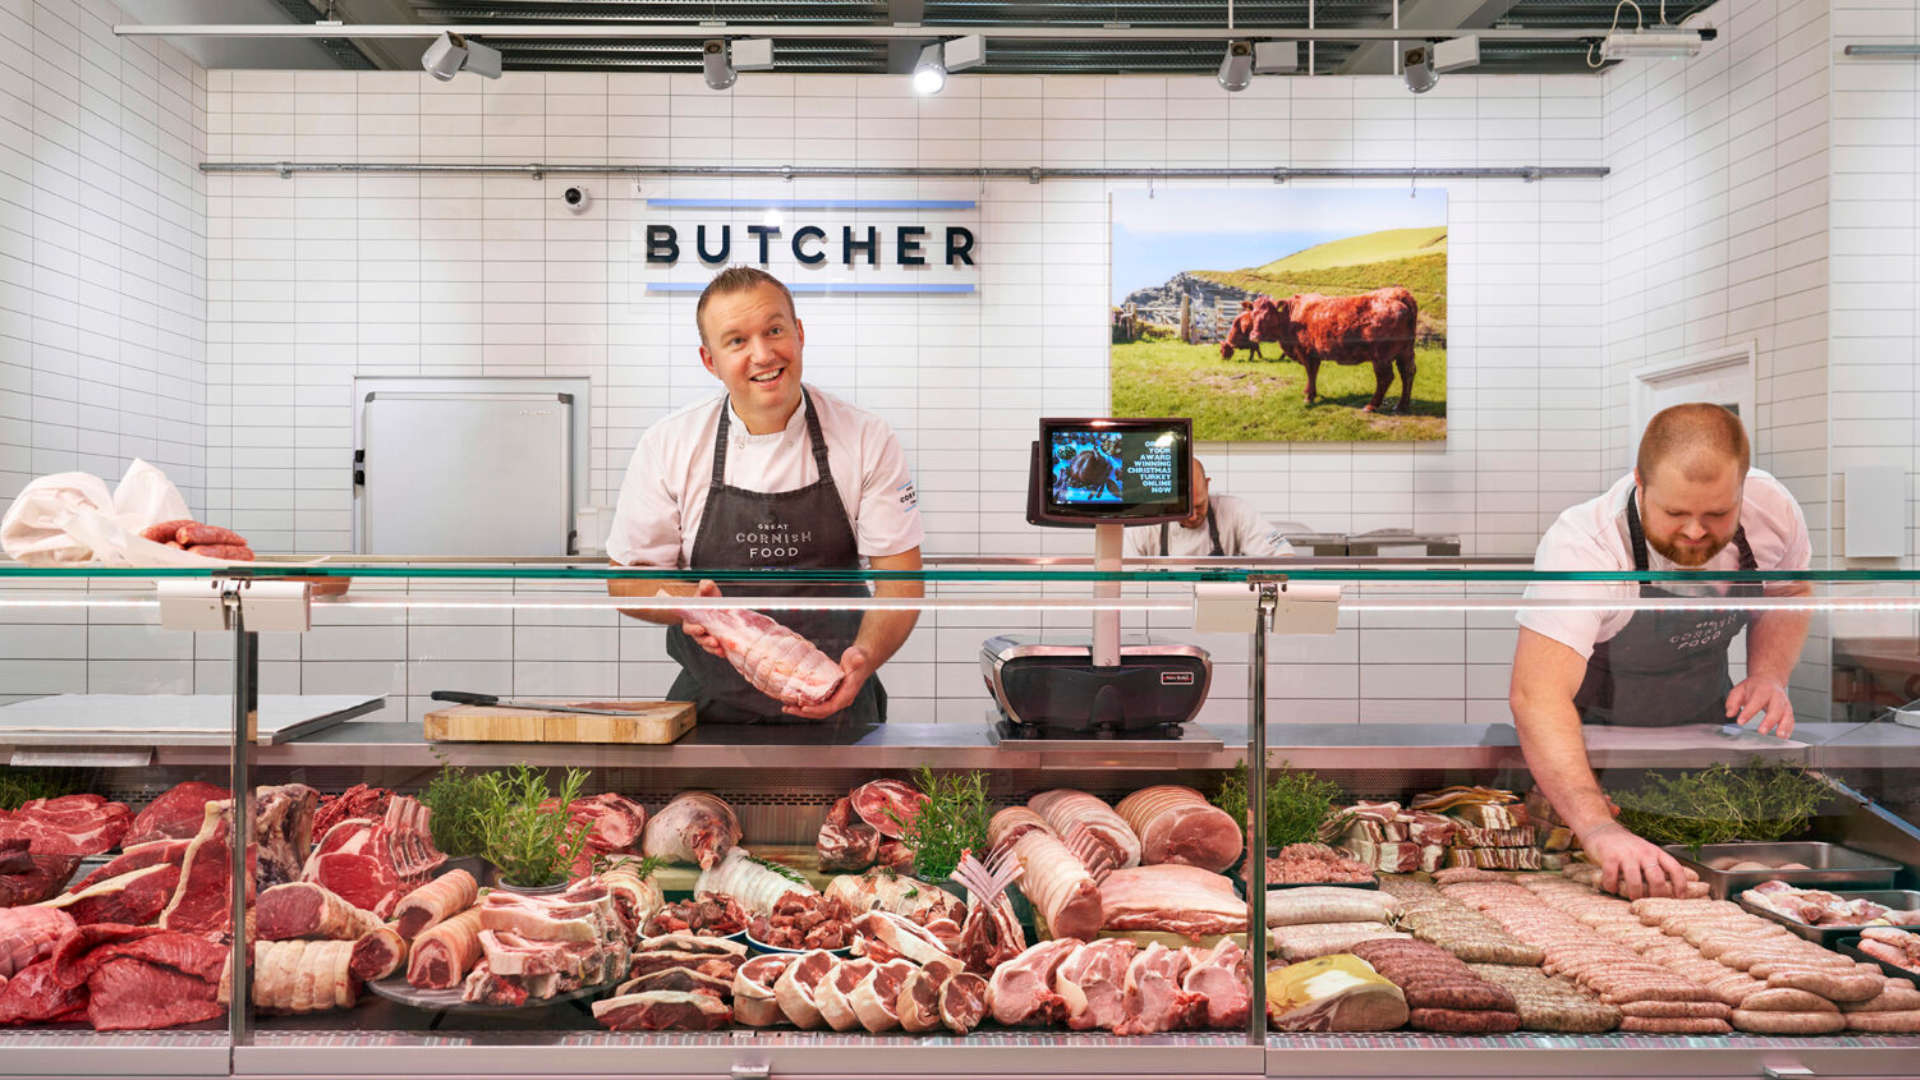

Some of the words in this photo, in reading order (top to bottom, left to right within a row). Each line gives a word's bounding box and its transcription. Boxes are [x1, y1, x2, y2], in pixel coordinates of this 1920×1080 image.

[646, 224, 975, 265] BUTCHER
[735, 531, 812, 544] CORNISH
[749, 547, 799, 559] FOOD
